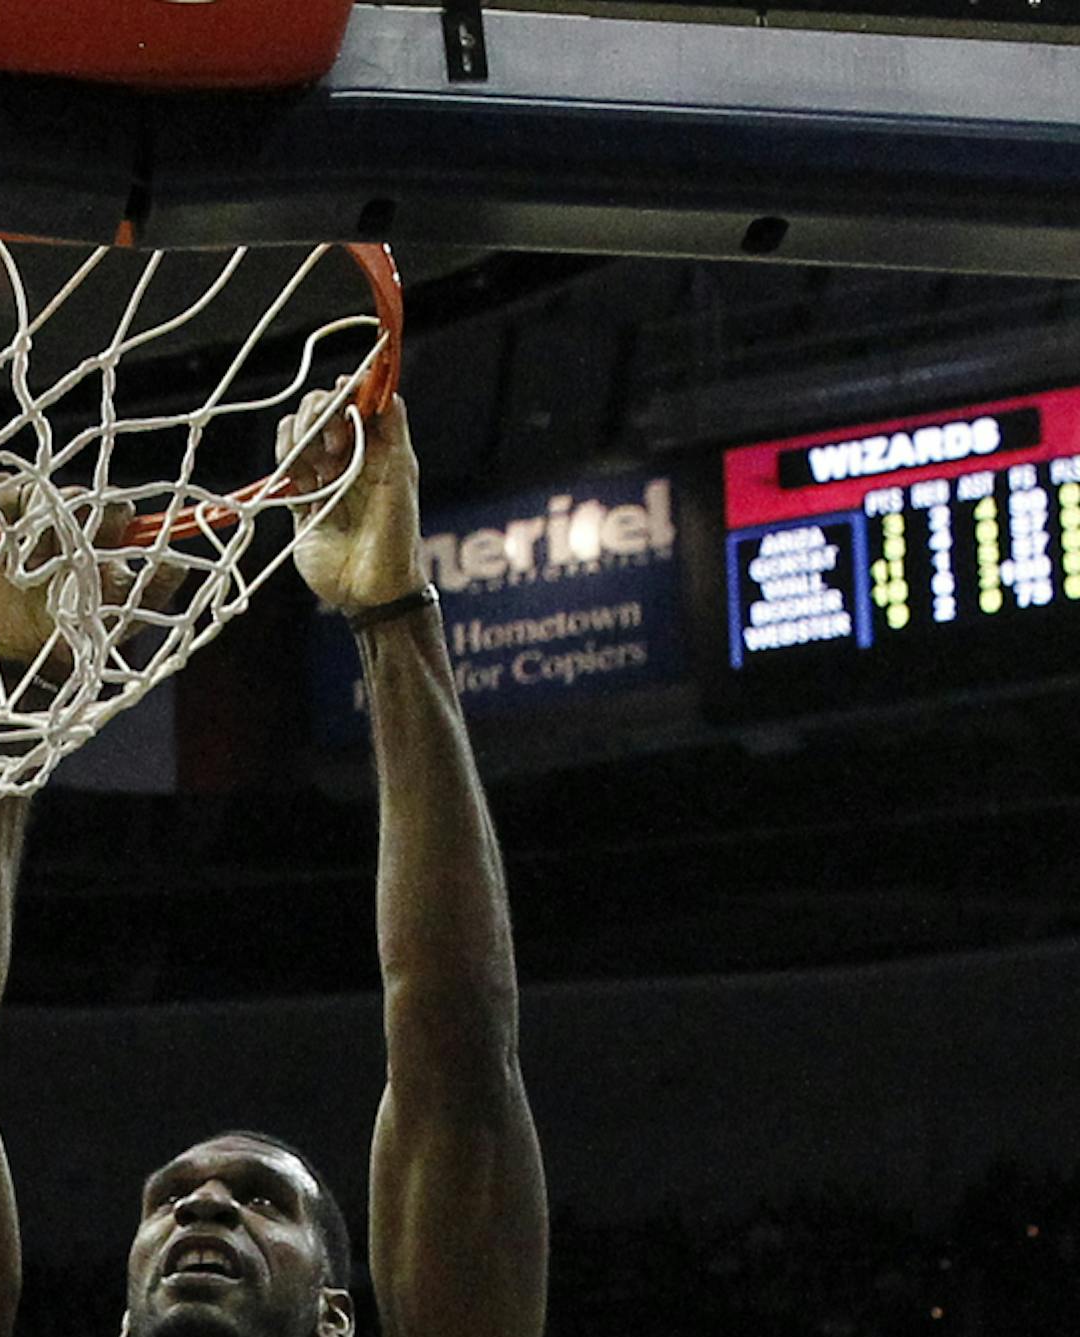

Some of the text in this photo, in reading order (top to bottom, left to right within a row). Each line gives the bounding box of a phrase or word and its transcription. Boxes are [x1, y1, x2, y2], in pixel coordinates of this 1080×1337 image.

[808, 416, 1000, 482] WIZARDS
[452, 600, 642, 656] Hometown
[511, 640, 648, 685] Copiers
